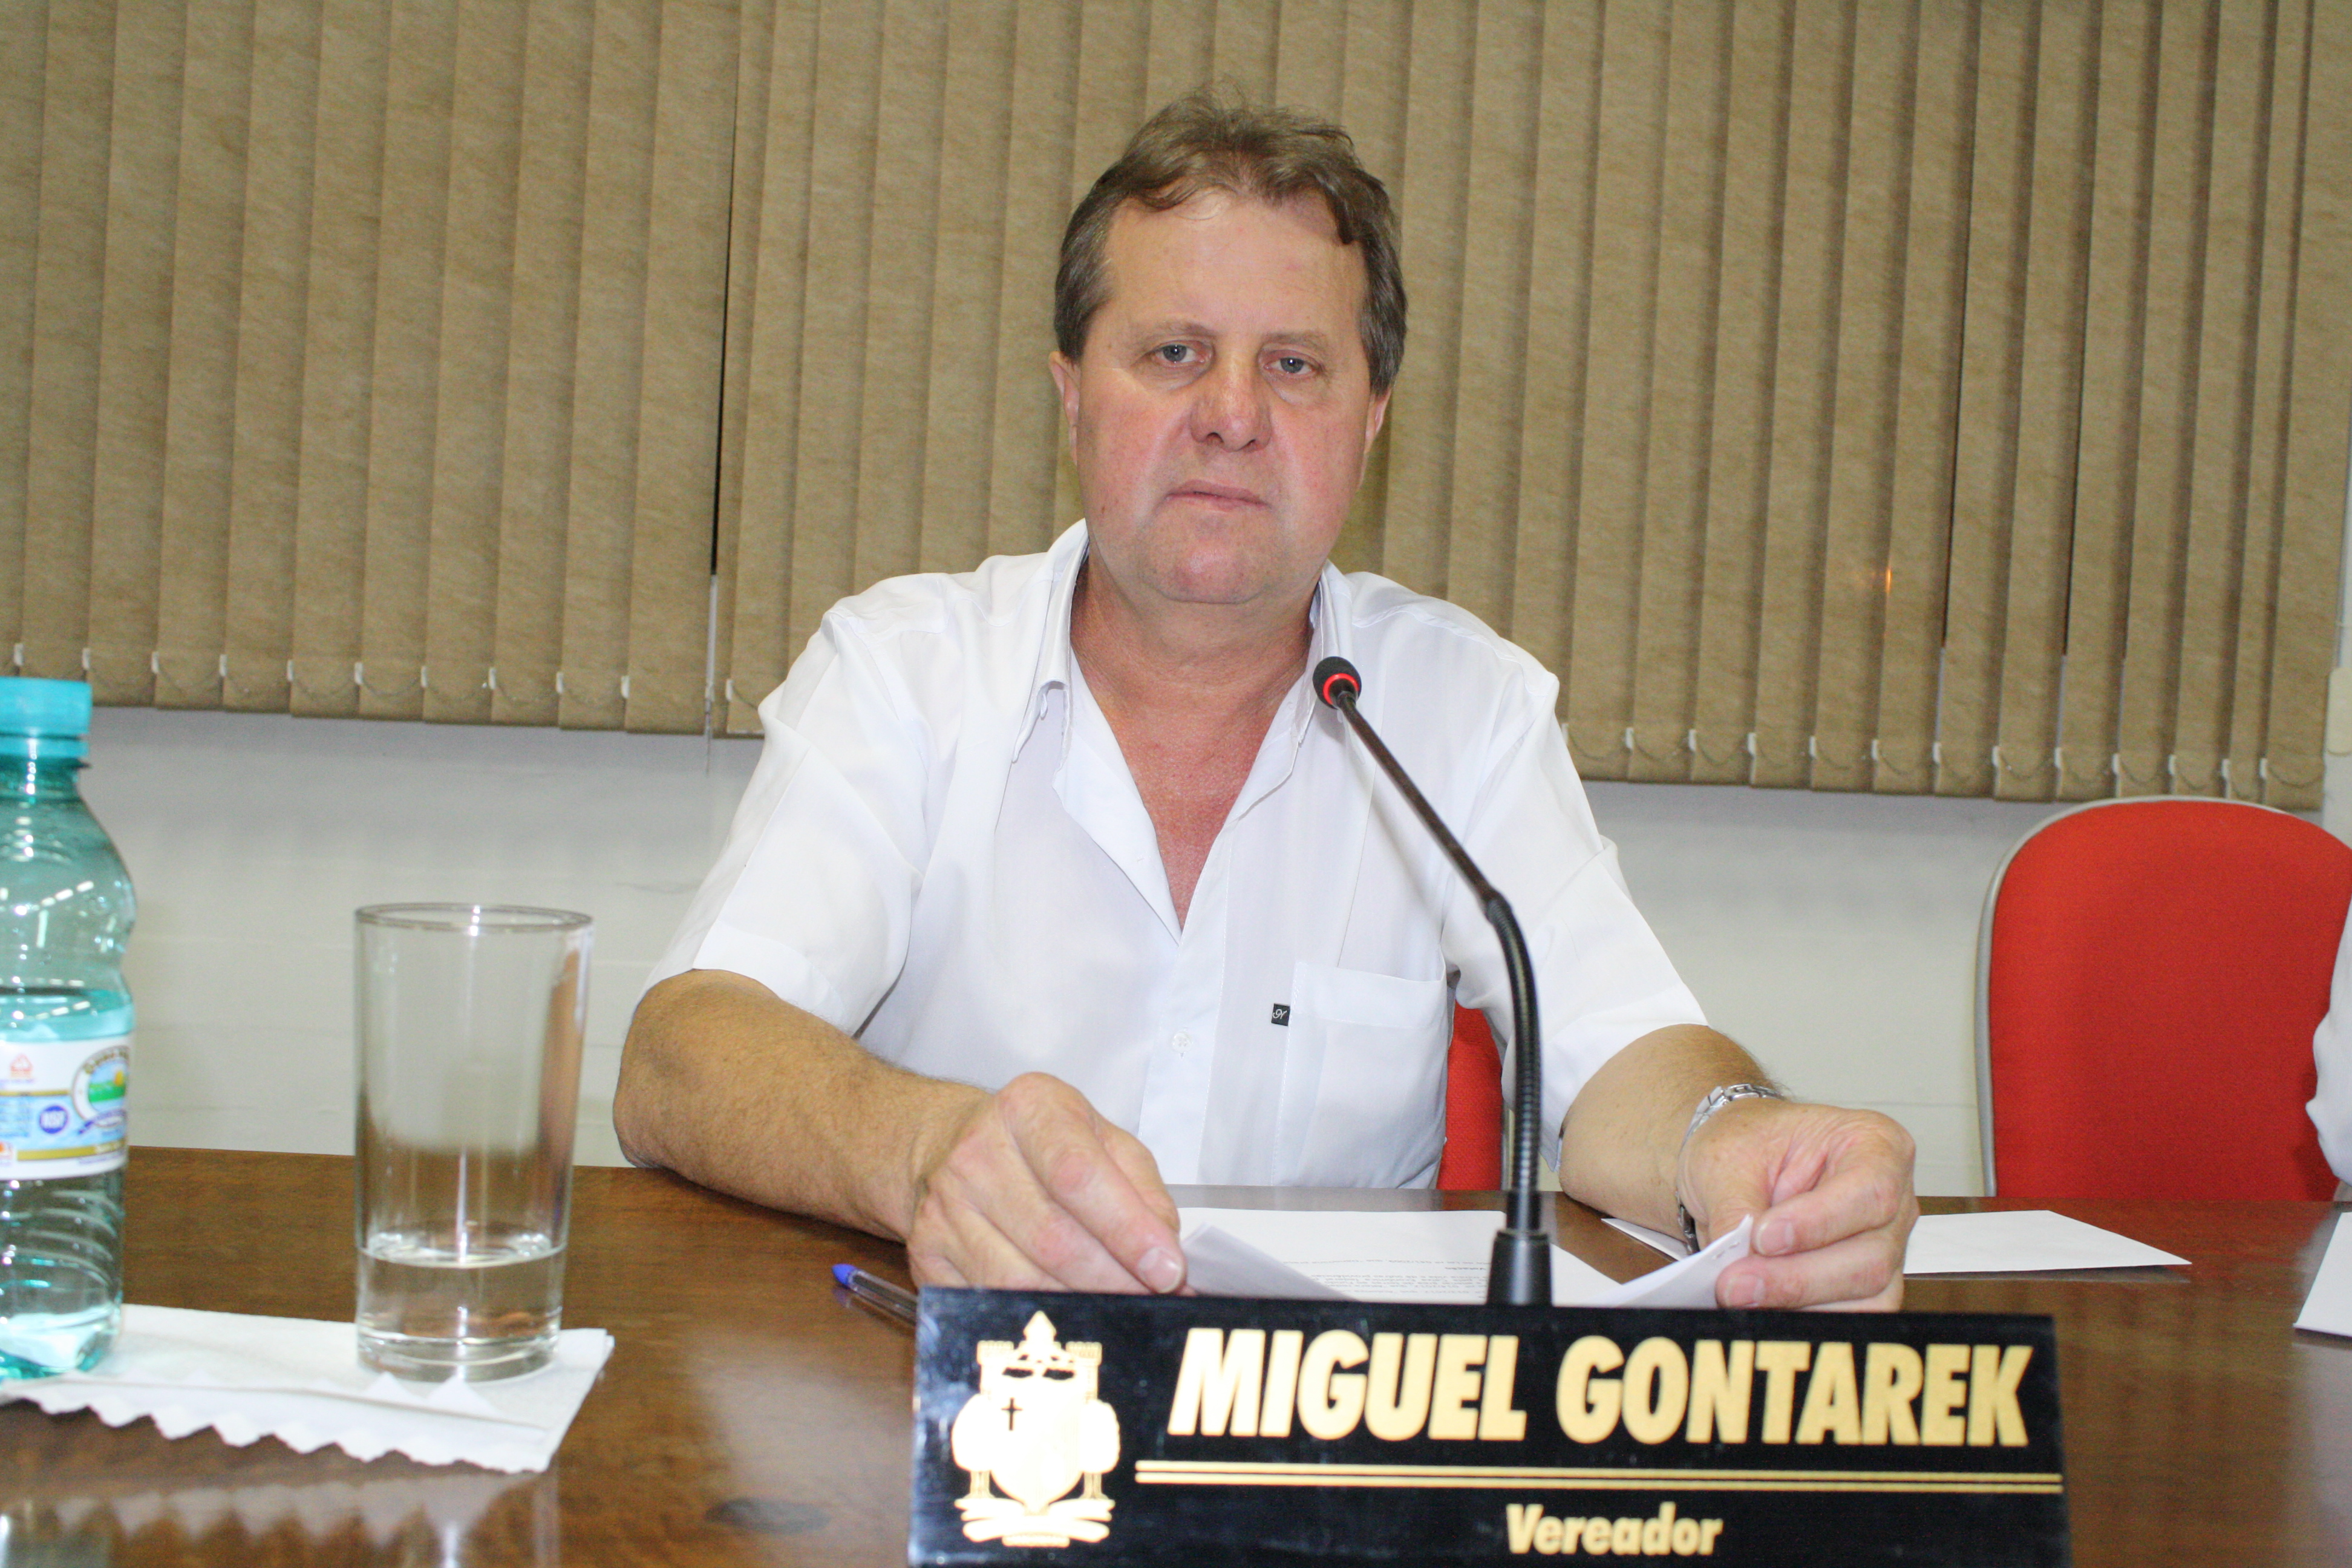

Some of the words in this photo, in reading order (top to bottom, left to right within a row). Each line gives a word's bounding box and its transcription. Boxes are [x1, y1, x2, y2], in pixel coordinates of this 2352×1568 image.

[1167, 1328, 1527, 1442] MIGUEL
[1557, 1336, 2033, 1446] GONTAREK
[1506, 1501, 1723, 1556] Vereador
